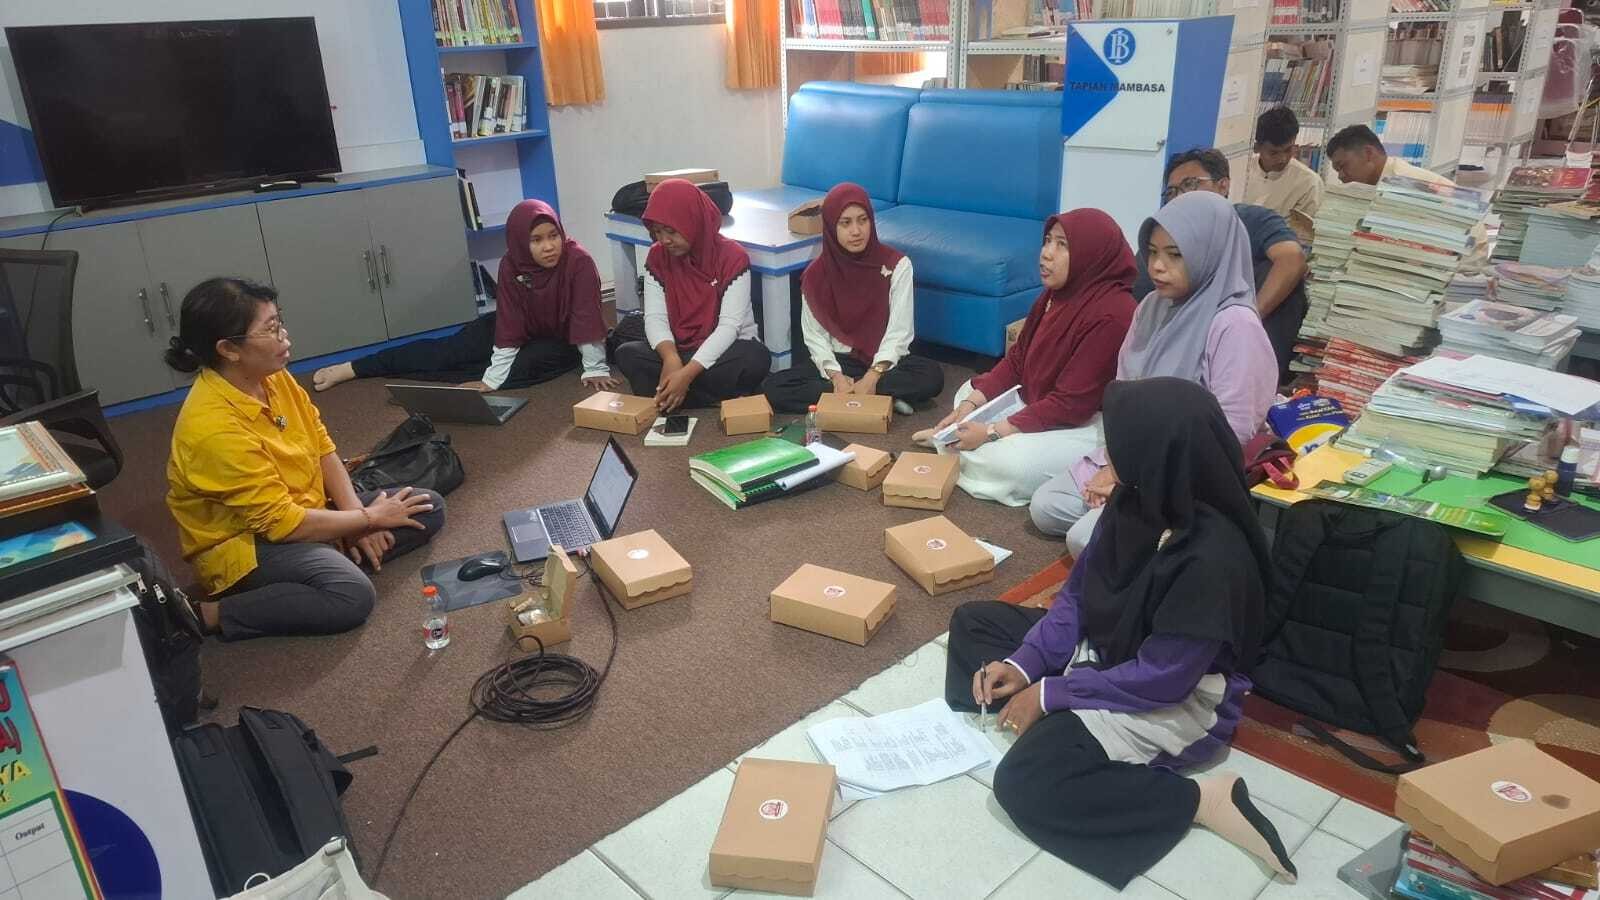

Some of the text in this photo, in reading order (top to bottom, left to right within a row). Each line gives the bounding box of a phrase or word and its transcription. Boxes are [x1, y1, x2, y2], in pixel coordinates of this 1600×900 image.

[1071, 81, 1166, 92] TAPIAN MAMBASA
[15, 823, 45, 841] Output
